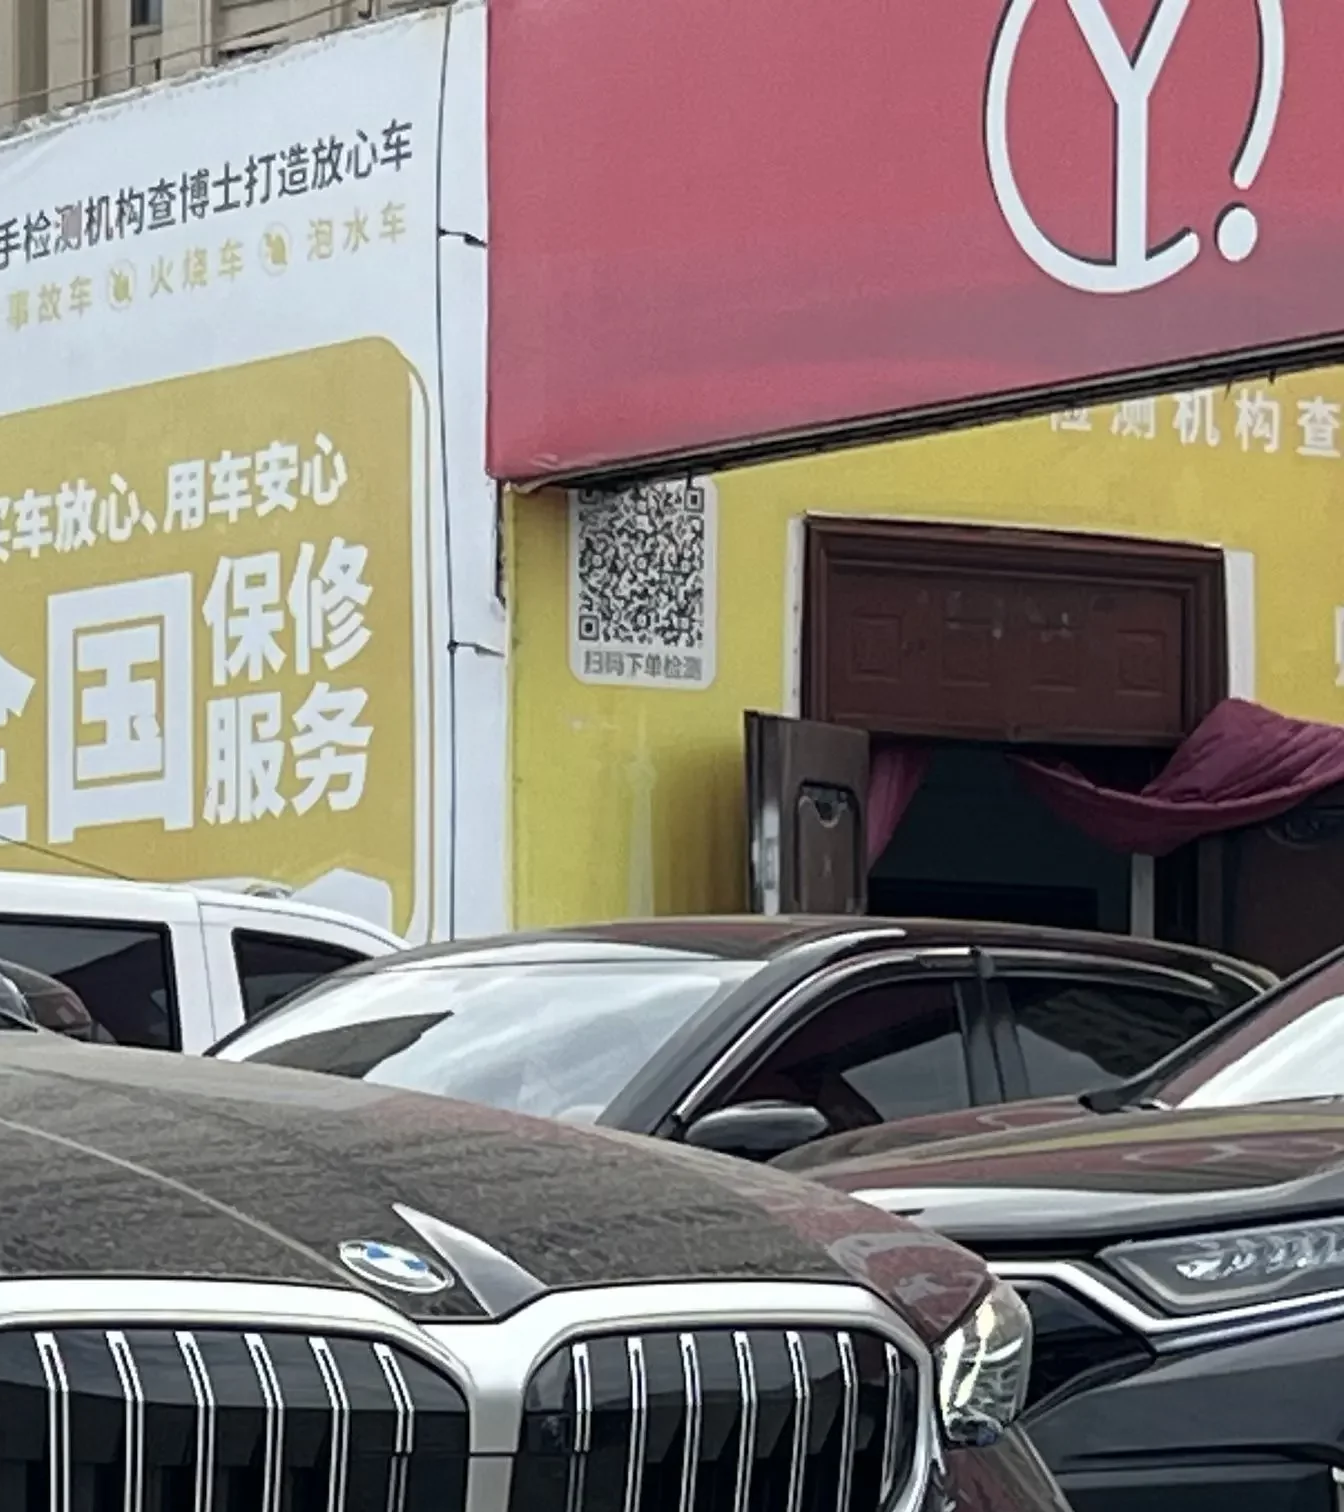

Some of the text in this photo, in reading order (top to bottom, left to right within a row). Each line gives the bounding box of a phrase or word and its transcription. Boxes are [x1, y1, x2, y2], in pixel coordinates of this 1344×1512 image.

[6, 275, 92, 331] 事故车
[149, 238, 244, 298] 火烧车
[307, 200, 406, 261] 泡水车
[202, 536, 373, 686] 保修
[203, 681, 374, 826] 服务
